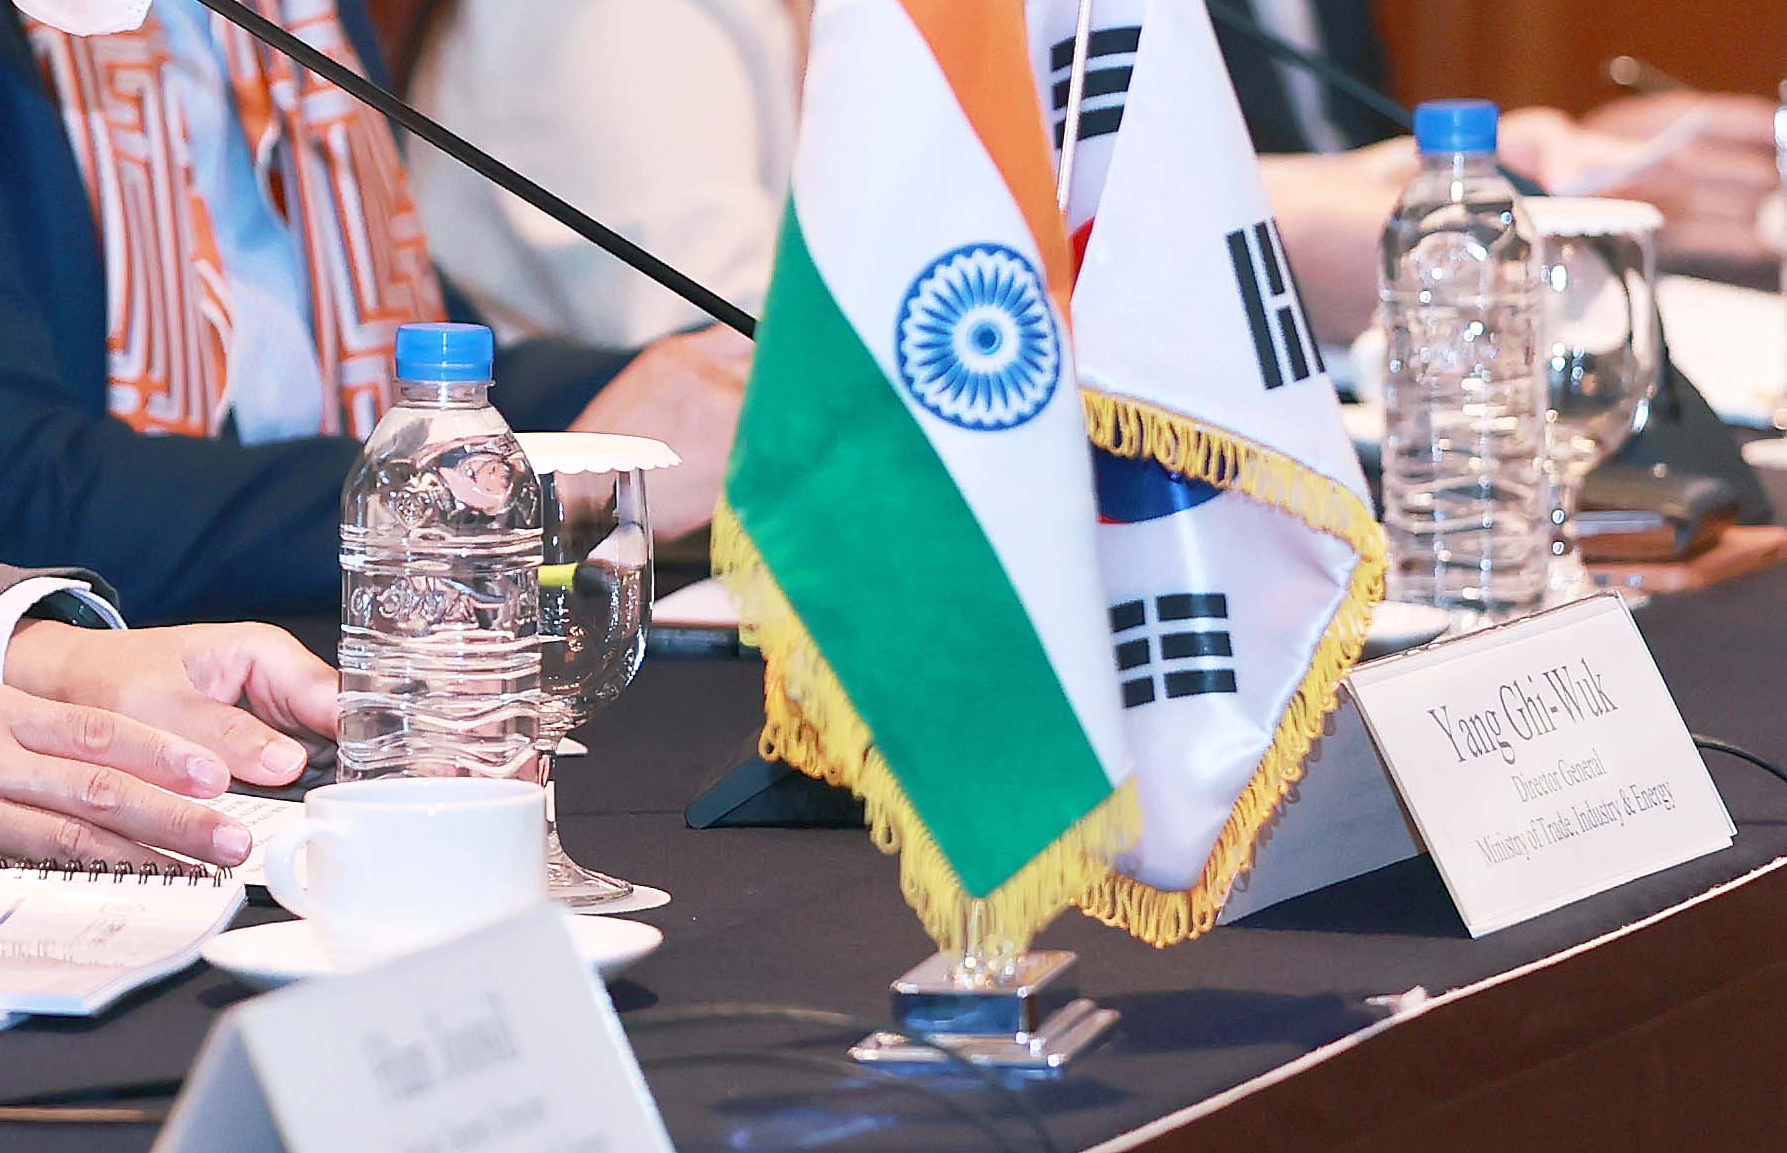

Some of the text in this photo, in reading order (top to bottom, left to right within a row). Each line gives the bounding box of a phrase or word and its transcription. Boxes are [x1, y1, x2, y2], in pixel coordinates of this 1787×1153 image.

[1427, 657, 1619, 765] Yang Ghi-Wuk
[1511, 748, 1607, 803] Director General
[1476, 833, 1531, 866] Ministry
[1527, 819, 1543, 851] of
[1571, 800, 1625, 827] Industry
[1618, 787, 1636, 816] &
[1629, 781, 1676, 811] Energy
